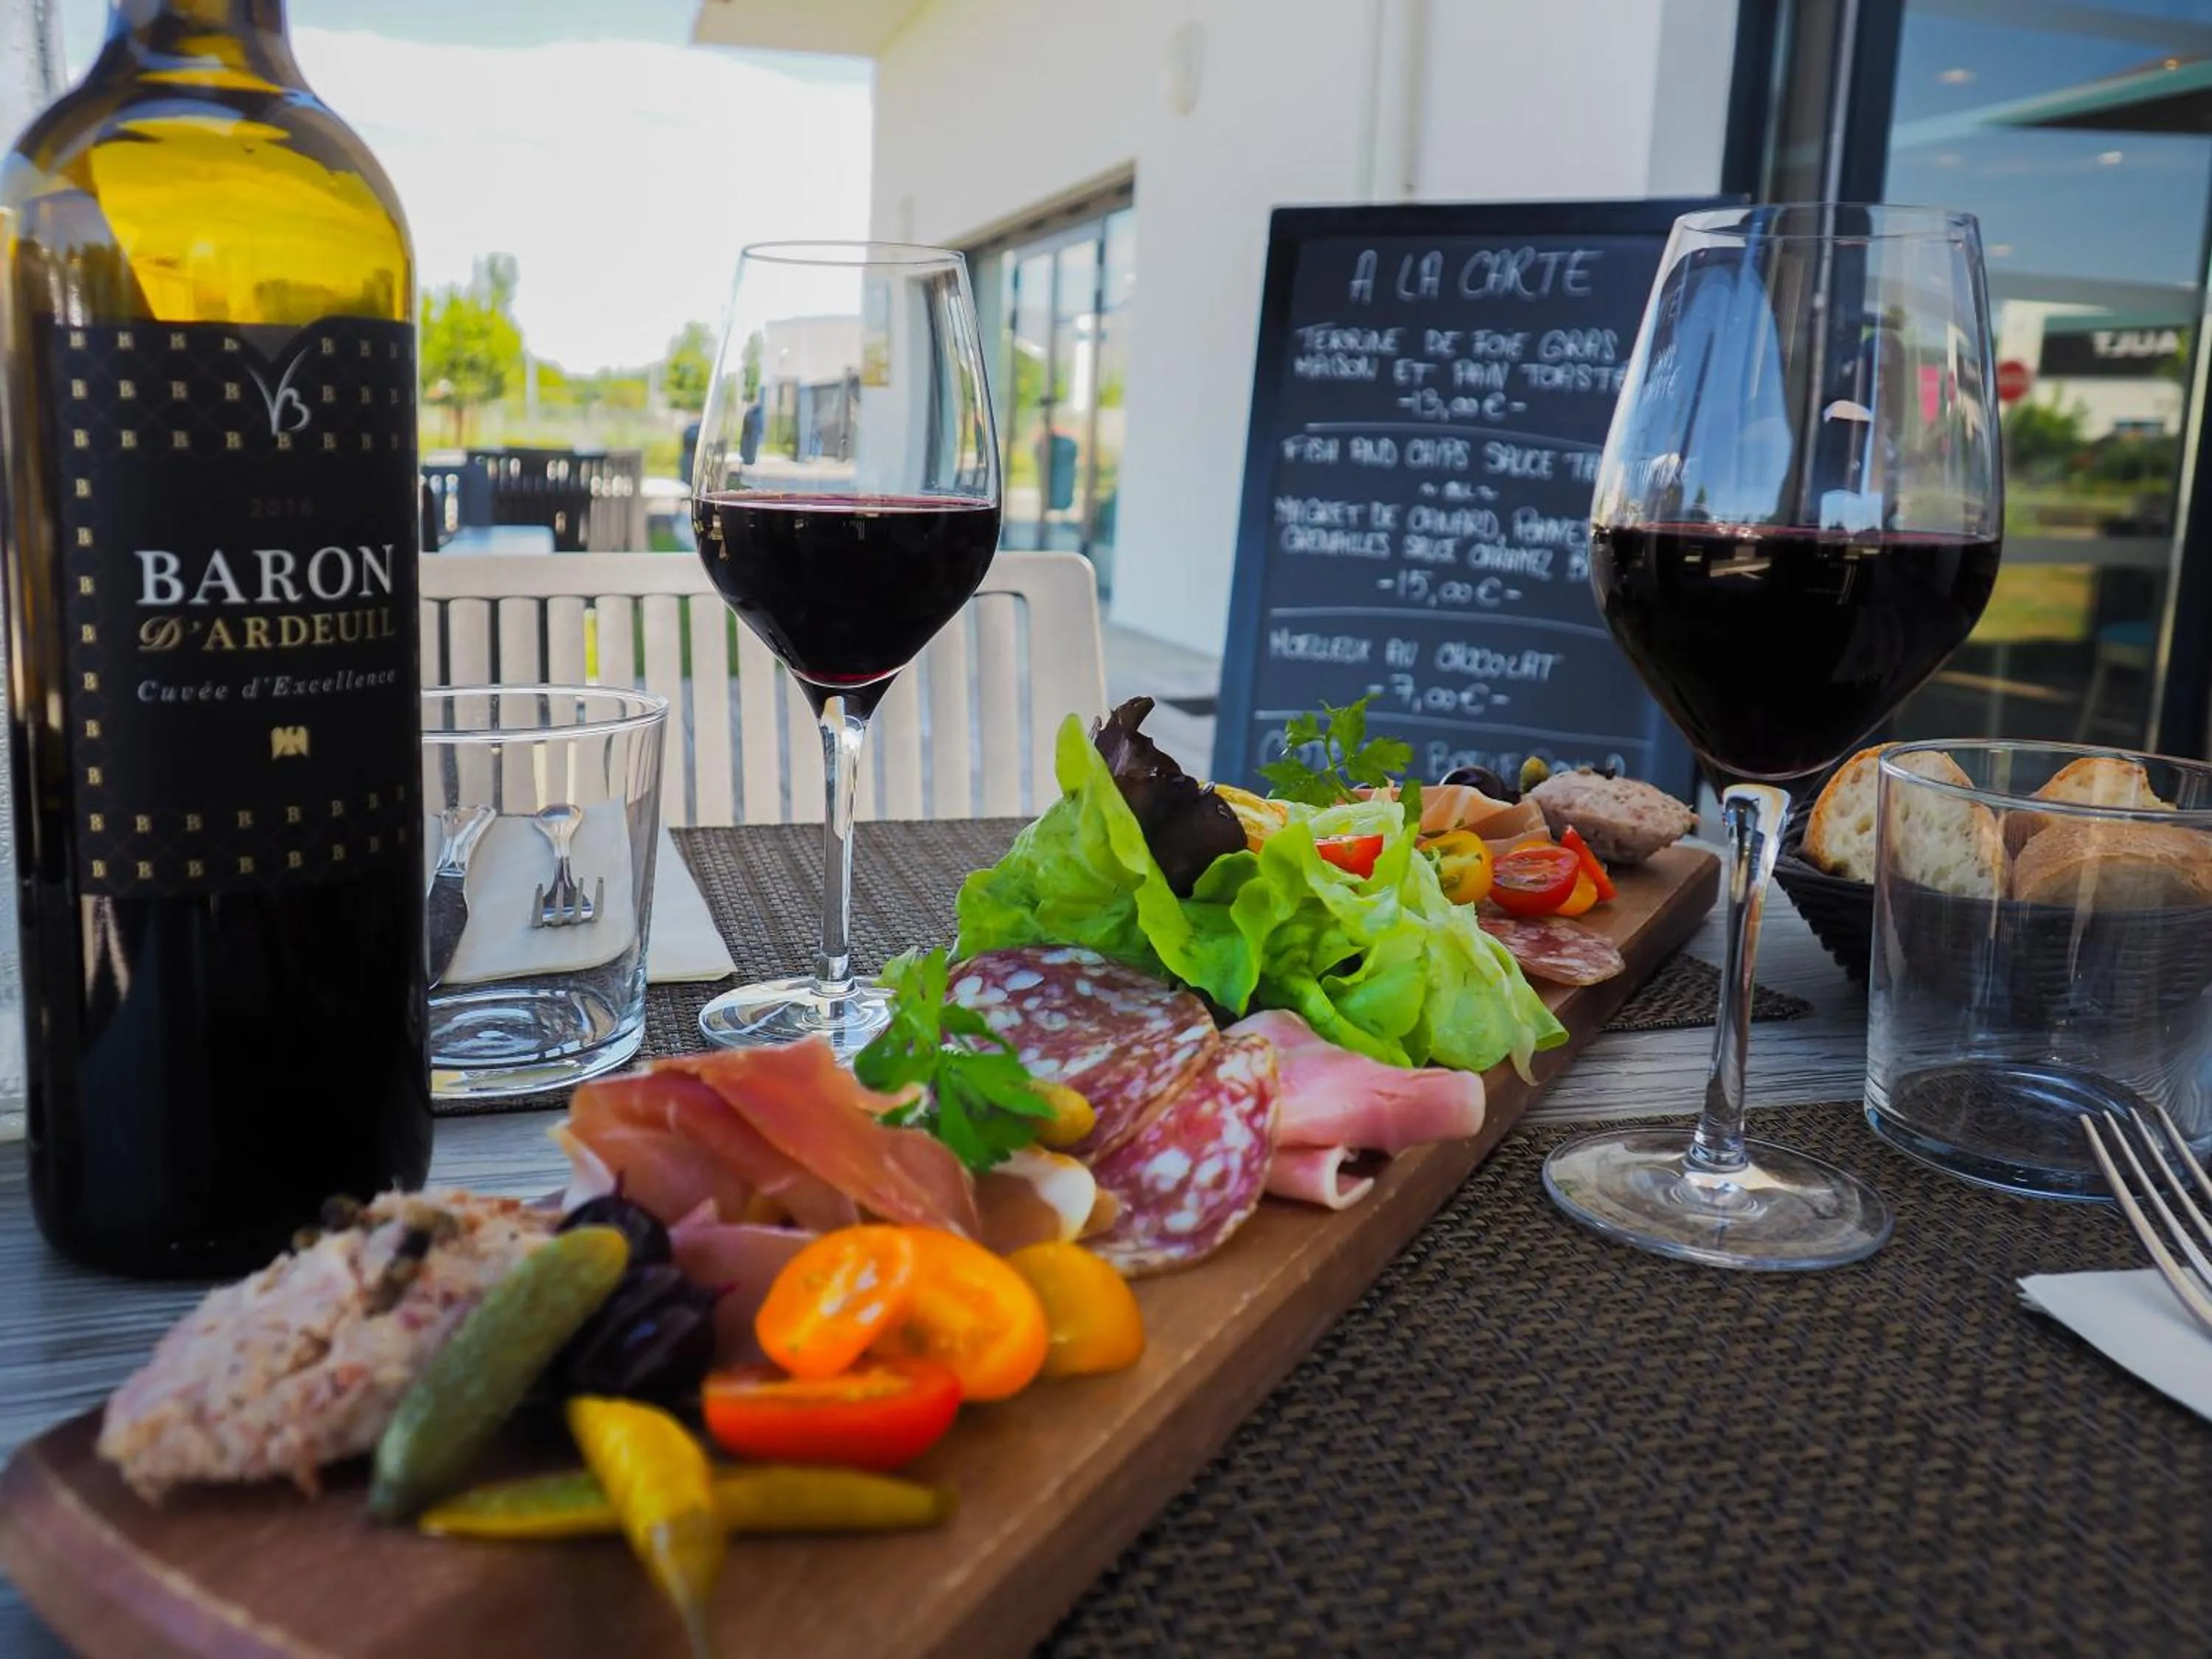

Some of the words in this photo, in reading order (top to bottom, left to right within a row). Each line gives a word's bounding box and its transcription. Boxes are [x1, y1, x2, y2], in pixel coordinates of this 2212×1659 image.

[1349, 249, 1378, 306] A
[1396, 250, 1444, 302] LA
[1458, 245, 1604, 302] CARTE
[1295, 321, 1405, 355] TERRINE
[1424, 328, 1464, 357] DE
[1472, 328, 1532, 361] FOIE
[1538, 327, 1618, 364] GRAS
[1393, 357, 1439, 387] ET
[1451, 358, 1511, 391] PAIN
[1281, 434, 1340, 465] FISH
[1349, 435, 1399, 469] AND
[1404, 436, 1470, 472] CHIPS
[1484, 440, 1559, 481] SAUCE
[1369, 499, 1399, 531] DE
[1402, 533, 1460, 565] SAUCE
[133, 544, 394, 606] BARON
[1385, 637, 1419, 669] AU
[1433, 640, 1567, 682] CHOCOLAT
[137, 677, 230, 703] Cuvée
[242, 668, 396, 698] d'Excellence
